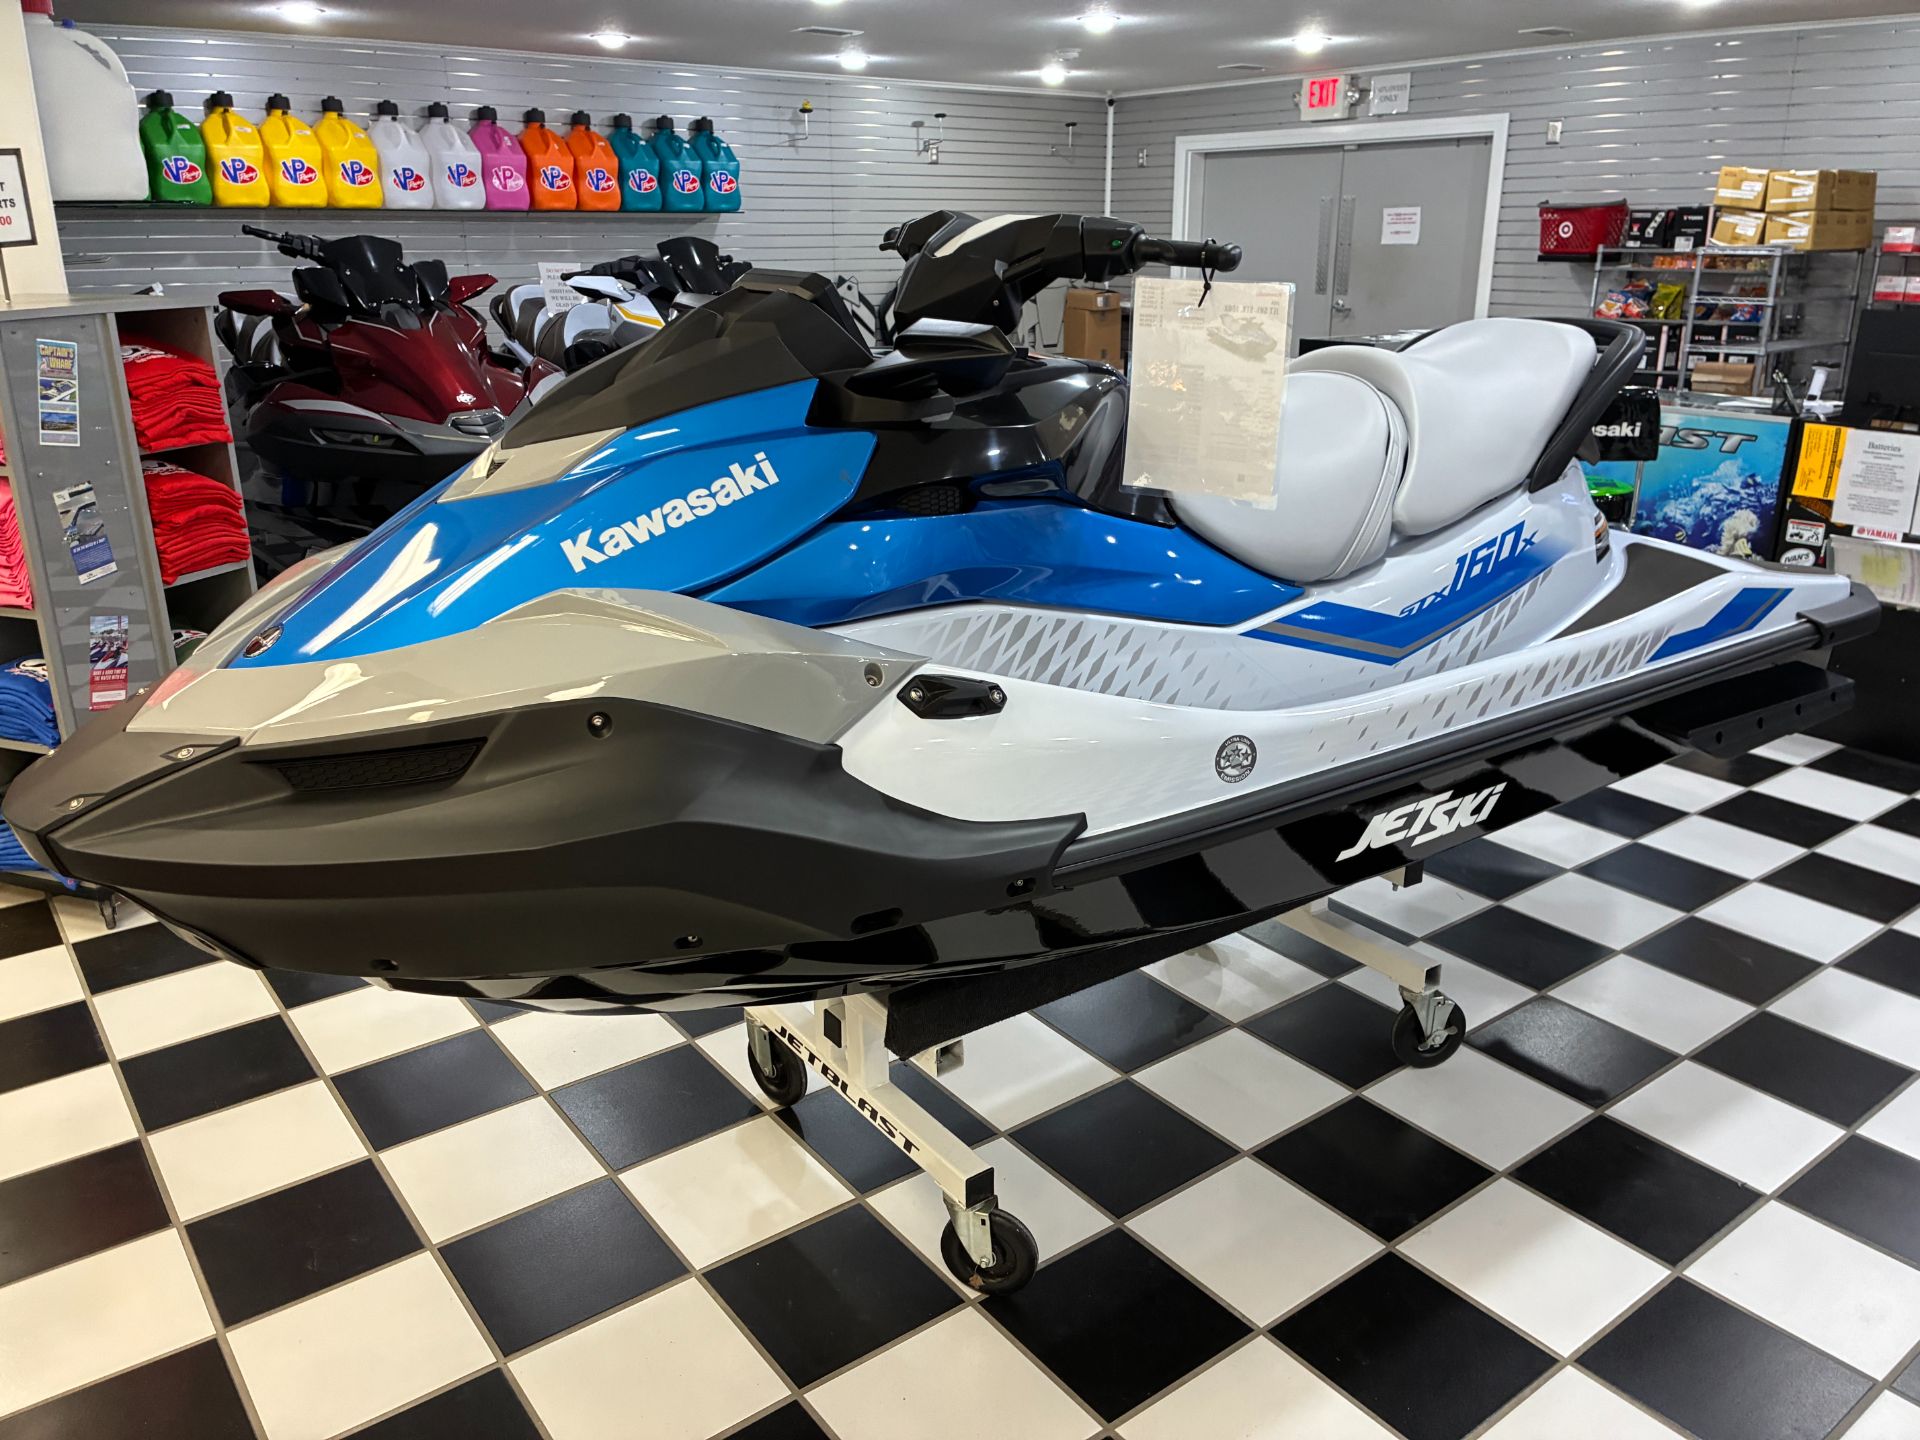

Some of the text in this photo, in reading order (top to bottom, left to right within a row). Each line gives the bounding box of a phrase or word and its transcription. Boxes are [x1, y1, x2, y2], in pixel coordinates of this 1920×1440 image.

[1308, 79, 1340, 108] EXIT
[163, 157, 189, 183] VP
[221, 158, 246, 184] VP
[282, 159, 306, 184] VP
[341, 161, 363, 185] VP
[393, 167, 415, 191] VP
[447, 163, 468, 187] VP
[493, 167, 514, 190] VP
[542, 167, 561, 189] VP
[587, 169, 606, 191] VP
[630, 170, 648, 191] VP
[674, 171, 691, 192] VP
[712, 172, 729, 192] VP
[40, 345, 74, 358] CAPTAIN'S
[49, 357, 73, 369] WHARF
[559, 451, 780, 573] Kawasaki
[1866, 528, 1898, 540] YAMAHA
[774, 1026, 920, 1154] JETBLAST
